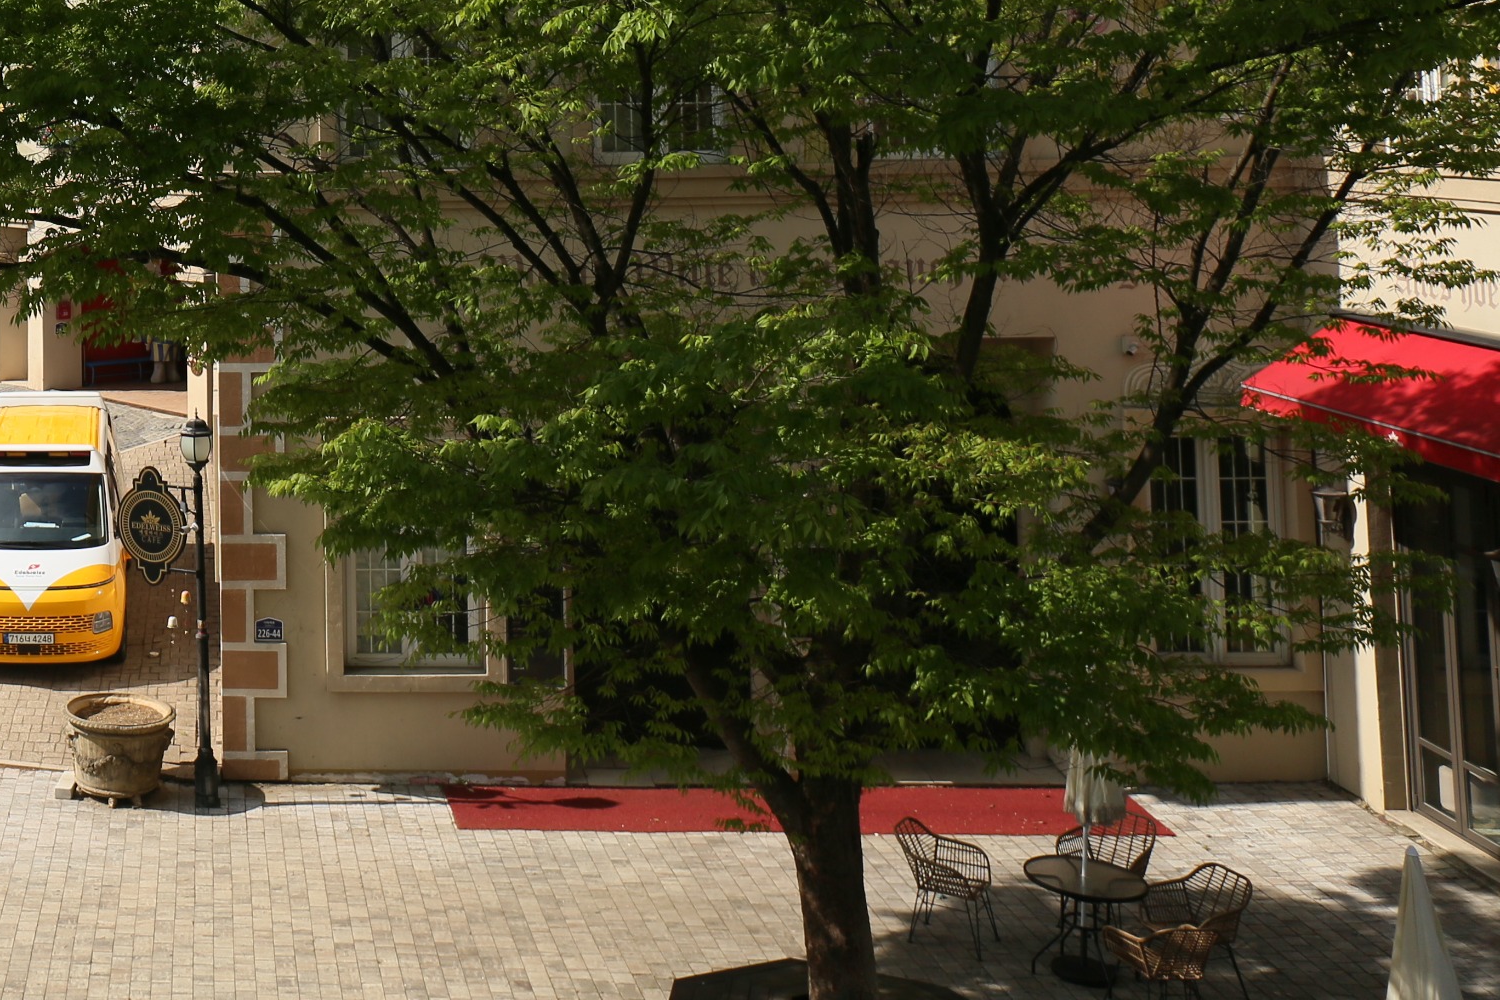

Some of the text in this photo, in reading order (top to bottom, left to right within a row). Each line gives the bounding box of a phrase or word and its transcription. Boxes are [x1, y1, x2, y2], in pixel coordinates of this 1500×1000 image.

[131, 521, 171, 533] EDELWEISS
[257, 629, 281, 638] 226-44
[32, 634, 52, 643] 4248
